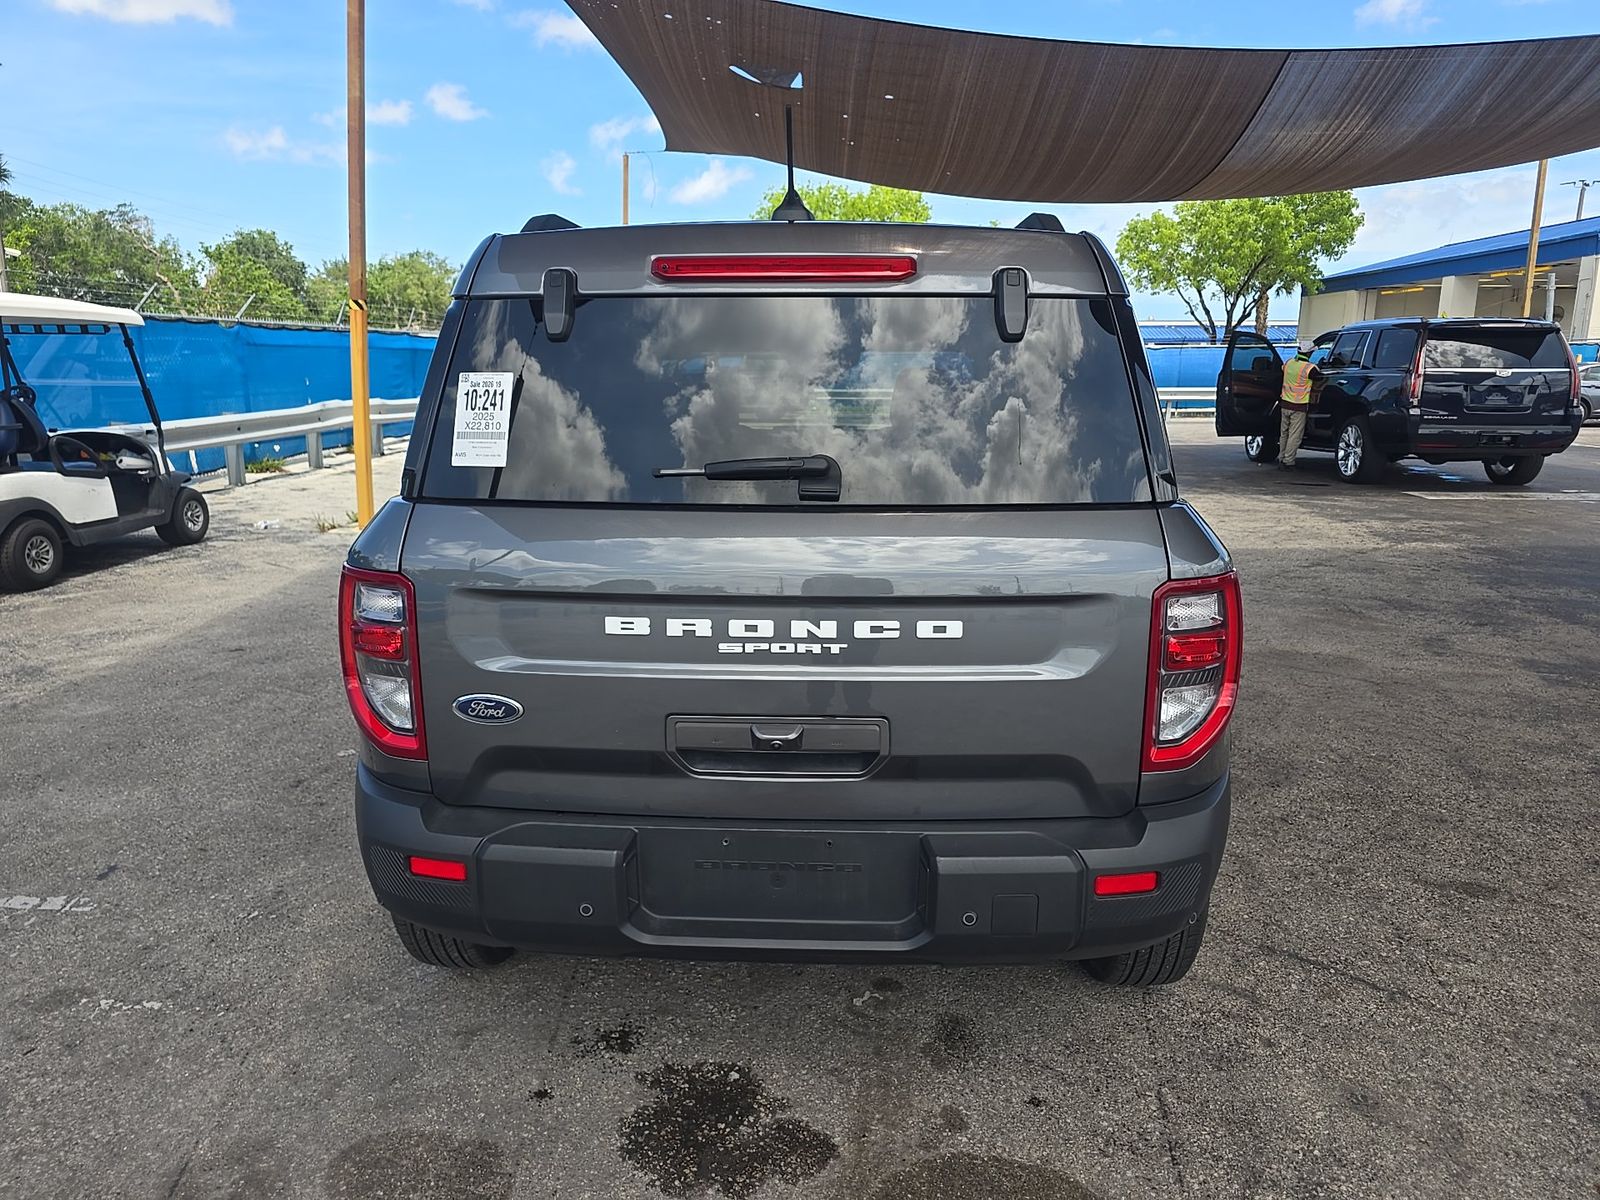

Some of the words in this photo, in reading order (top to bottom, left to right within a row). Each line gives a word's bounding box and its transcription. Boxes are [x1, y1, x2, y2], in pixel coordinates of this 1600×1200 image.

[464, 389, 505, 411] 10:241
[472, 412, 495, 421] 2025
[464, 421, 502, 431] X22,810
[604, 616, 964, 639] BRONCO
[717, 643, 848, 654] SPORT
[468, 700, 506, 718] Ford
[694, 860, 862, 872] BRONCO
